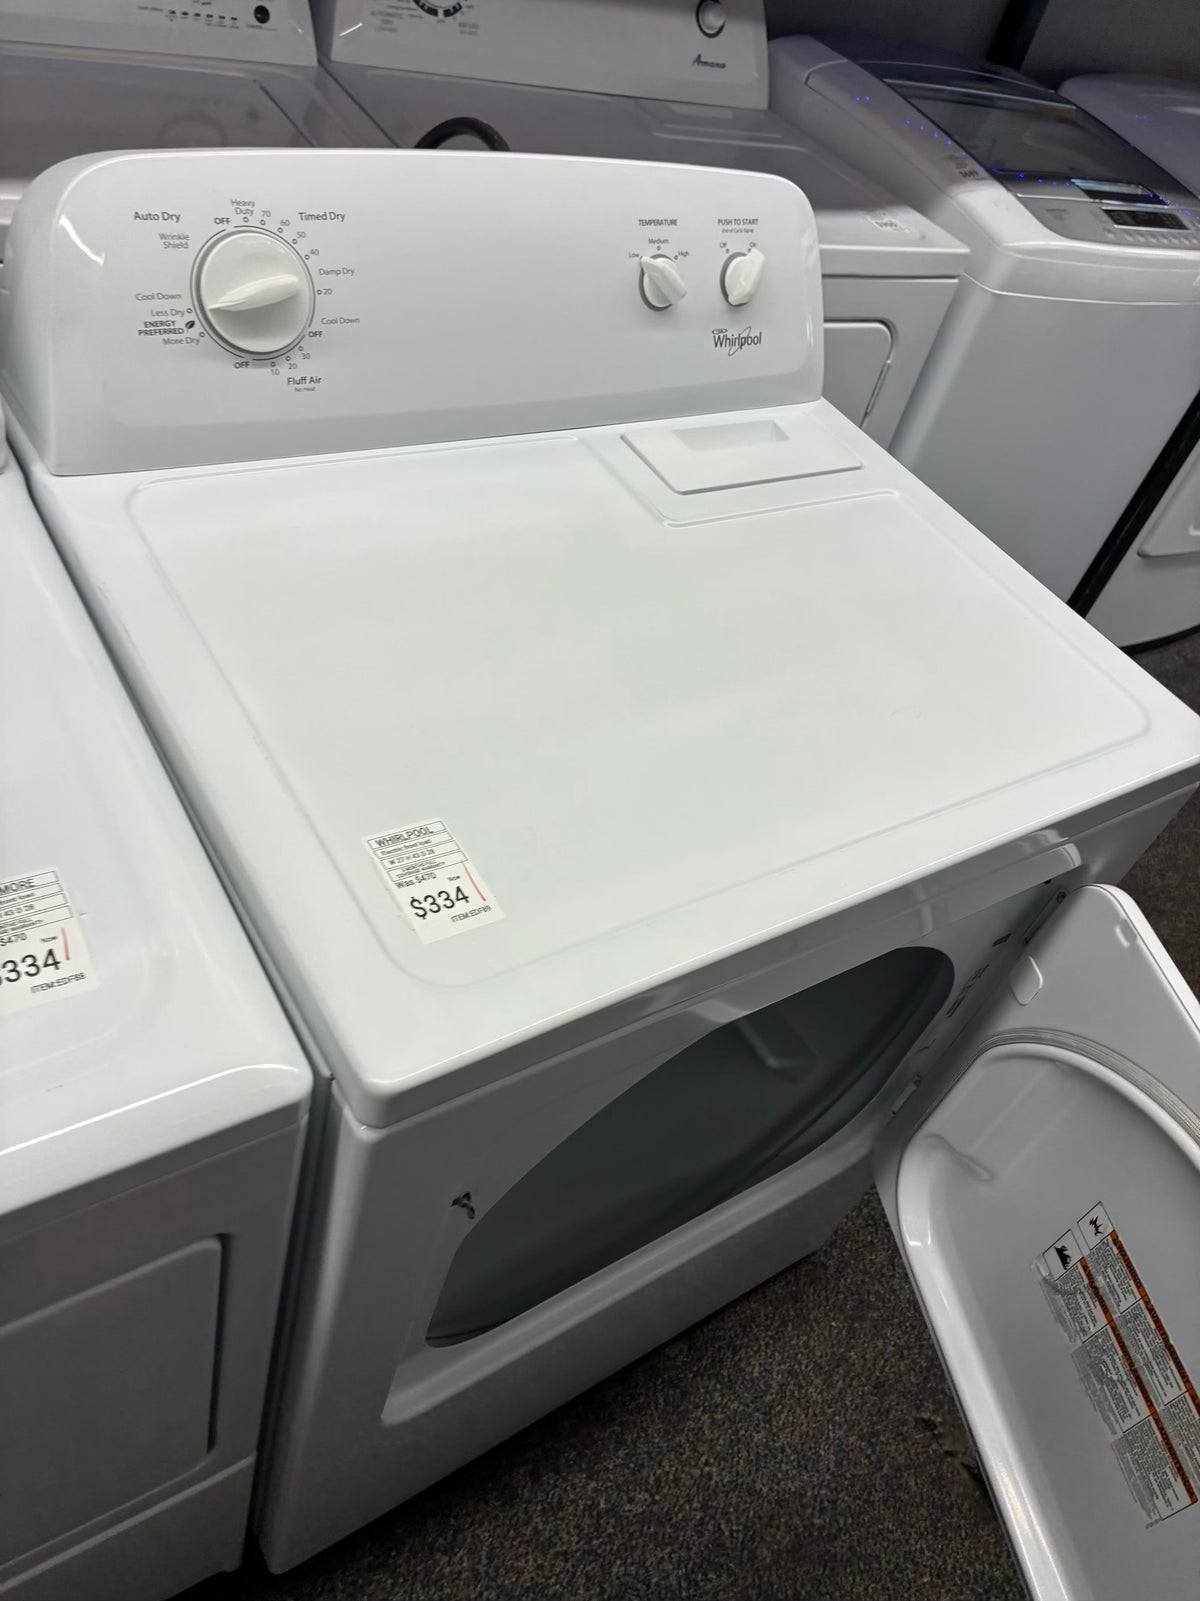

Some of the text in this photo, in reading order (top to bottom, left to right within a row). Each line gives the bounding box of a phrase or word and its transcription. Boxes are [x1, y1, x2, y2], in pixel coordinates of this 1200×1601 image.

[690, 53, 727, 69] Amana
[230, 199, 255, 209] Heavy
[234, 207, 254, 217] Duty
[261, 210, 271, 218] 70
[133, 212, 181, 223] Auto Dry
[214, 217, 231, 225] OFF
[298, 211, 346, 223] Timed Dry
[280, 219, 290, 227] 60
[638, 218, 678, 226] TEMPERATURE
[717, 218, 759, 226] PUSH TO START
[158, 233, 190, 241] Wrinkle
[296, 231, 306, 239] 50
[163, 241, 188, 249] Shield
[719, 241, 728, 249] Off
[310, 248, 320, 256] 40
[678, 250, 690, 258] High
[318, 267, 355, 277] Damp Dry
[323, 288, 333, 296] 20
[135, 292, 182, 301] Cool Down
[150, 309, 185, 319] Less Dry
[143, 320, 176, 329] ENERGY
[321, 316, 360, 325] Cool Down
[138, 328, 185, 337] PREFERRED
[308, 330, 324, 338] OFF
[162, 336, 200, 346] More Dry
[713, 331, 762, 351] Whirlpool
[301, 352, 311, 360] 30
[234, 361, 250, 369] OFF
[288, 362, 297, 370] 20
[271, 368, 280, 376] 10
[287, 375, 322, 386] Fluff Air
[375, 827, 434, 847] WHIRLPOOL
[394, 872, 437, 889] Was $470
[410, 886, 469, 920] $334
